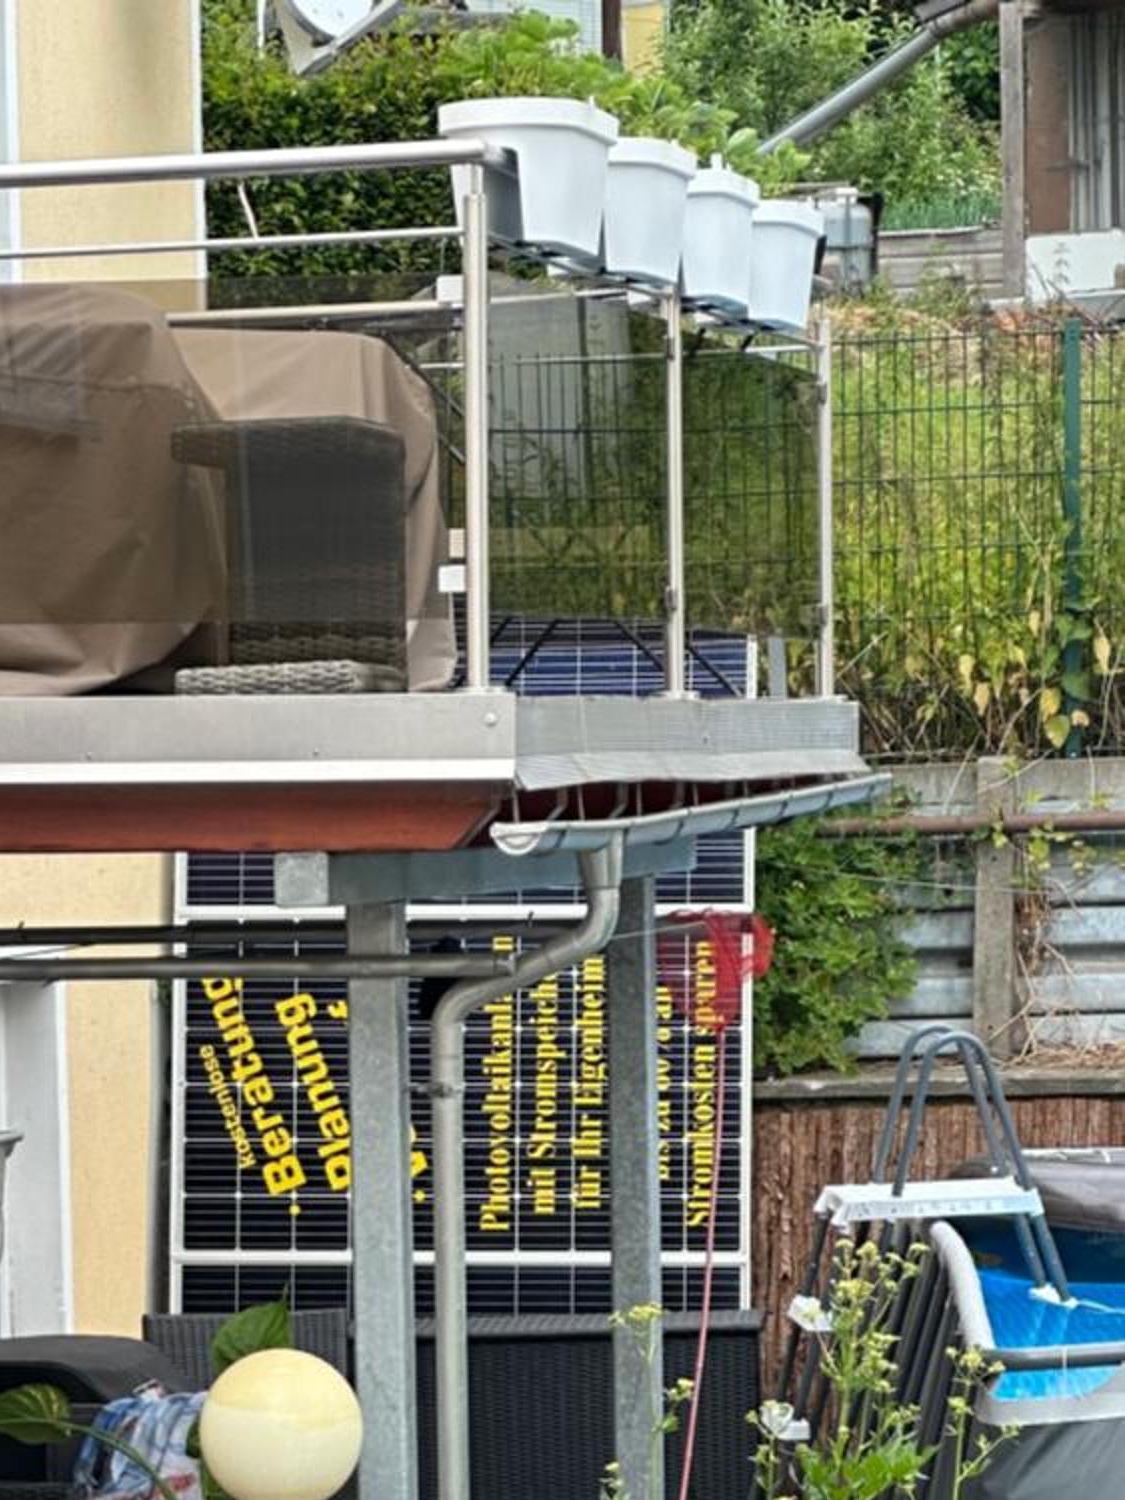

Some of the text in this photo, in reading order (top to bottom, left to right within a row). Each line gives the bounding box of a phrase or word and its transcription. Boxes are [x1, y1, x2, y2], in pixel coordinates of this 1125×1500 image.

[199, 1044, 257, 1169] kostenlose
[201, 977, 307, 1196] Beratung
[275, 993, 350, 1191] Planung
[479, 936, 513, 1231] Photovoltaikanln
[526, 971, 566, 1215] mit Stromspeich
[571, 956, 608, 1208] für Ihr Eigenheim
[685, 941, 724, 1228] Stromkosten sparen
